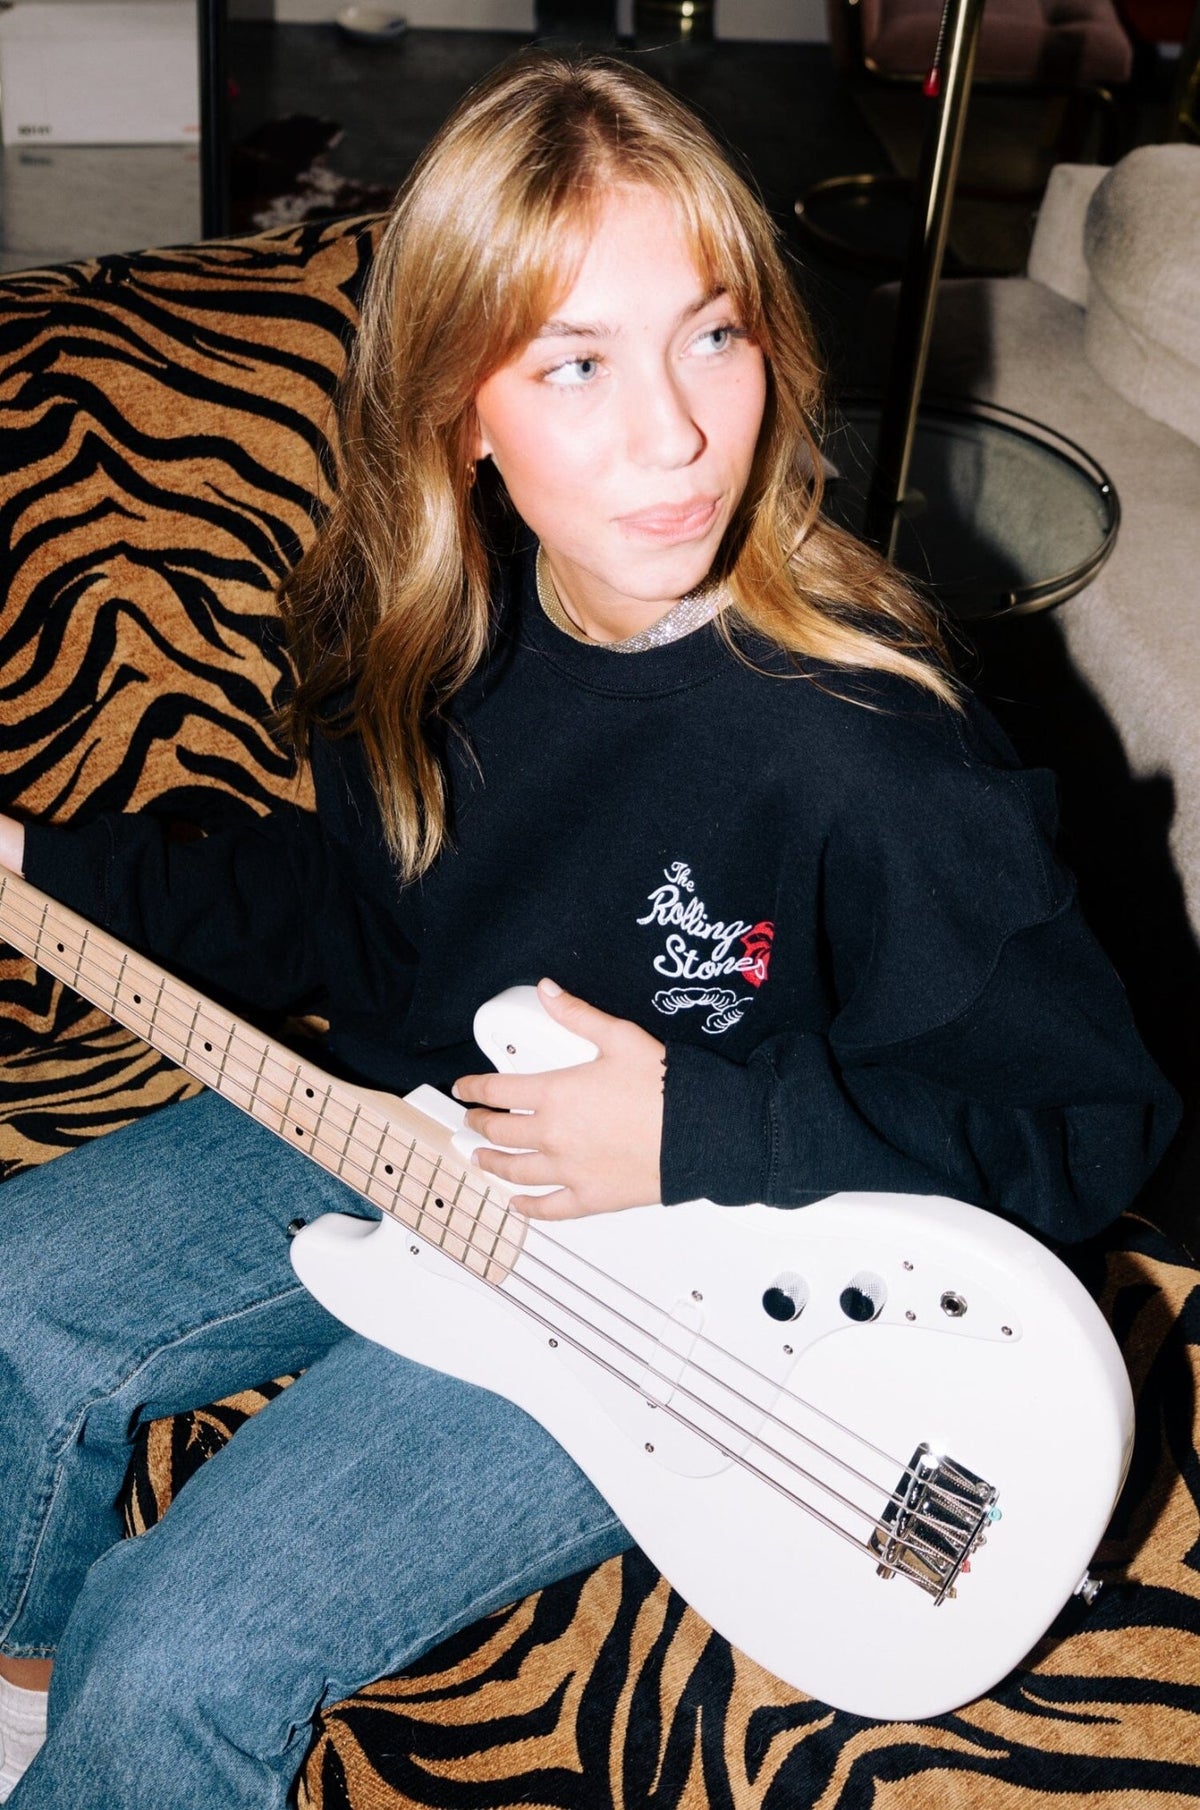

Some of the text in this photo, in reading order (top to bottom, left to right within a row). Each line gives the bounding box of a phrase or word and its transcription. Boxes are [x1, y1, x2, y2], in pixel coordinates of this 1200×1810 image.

[664, 861, 695, 892] The
[636, 884, 752, 961] Rolling
[653, 934, 766, 980] Stones
